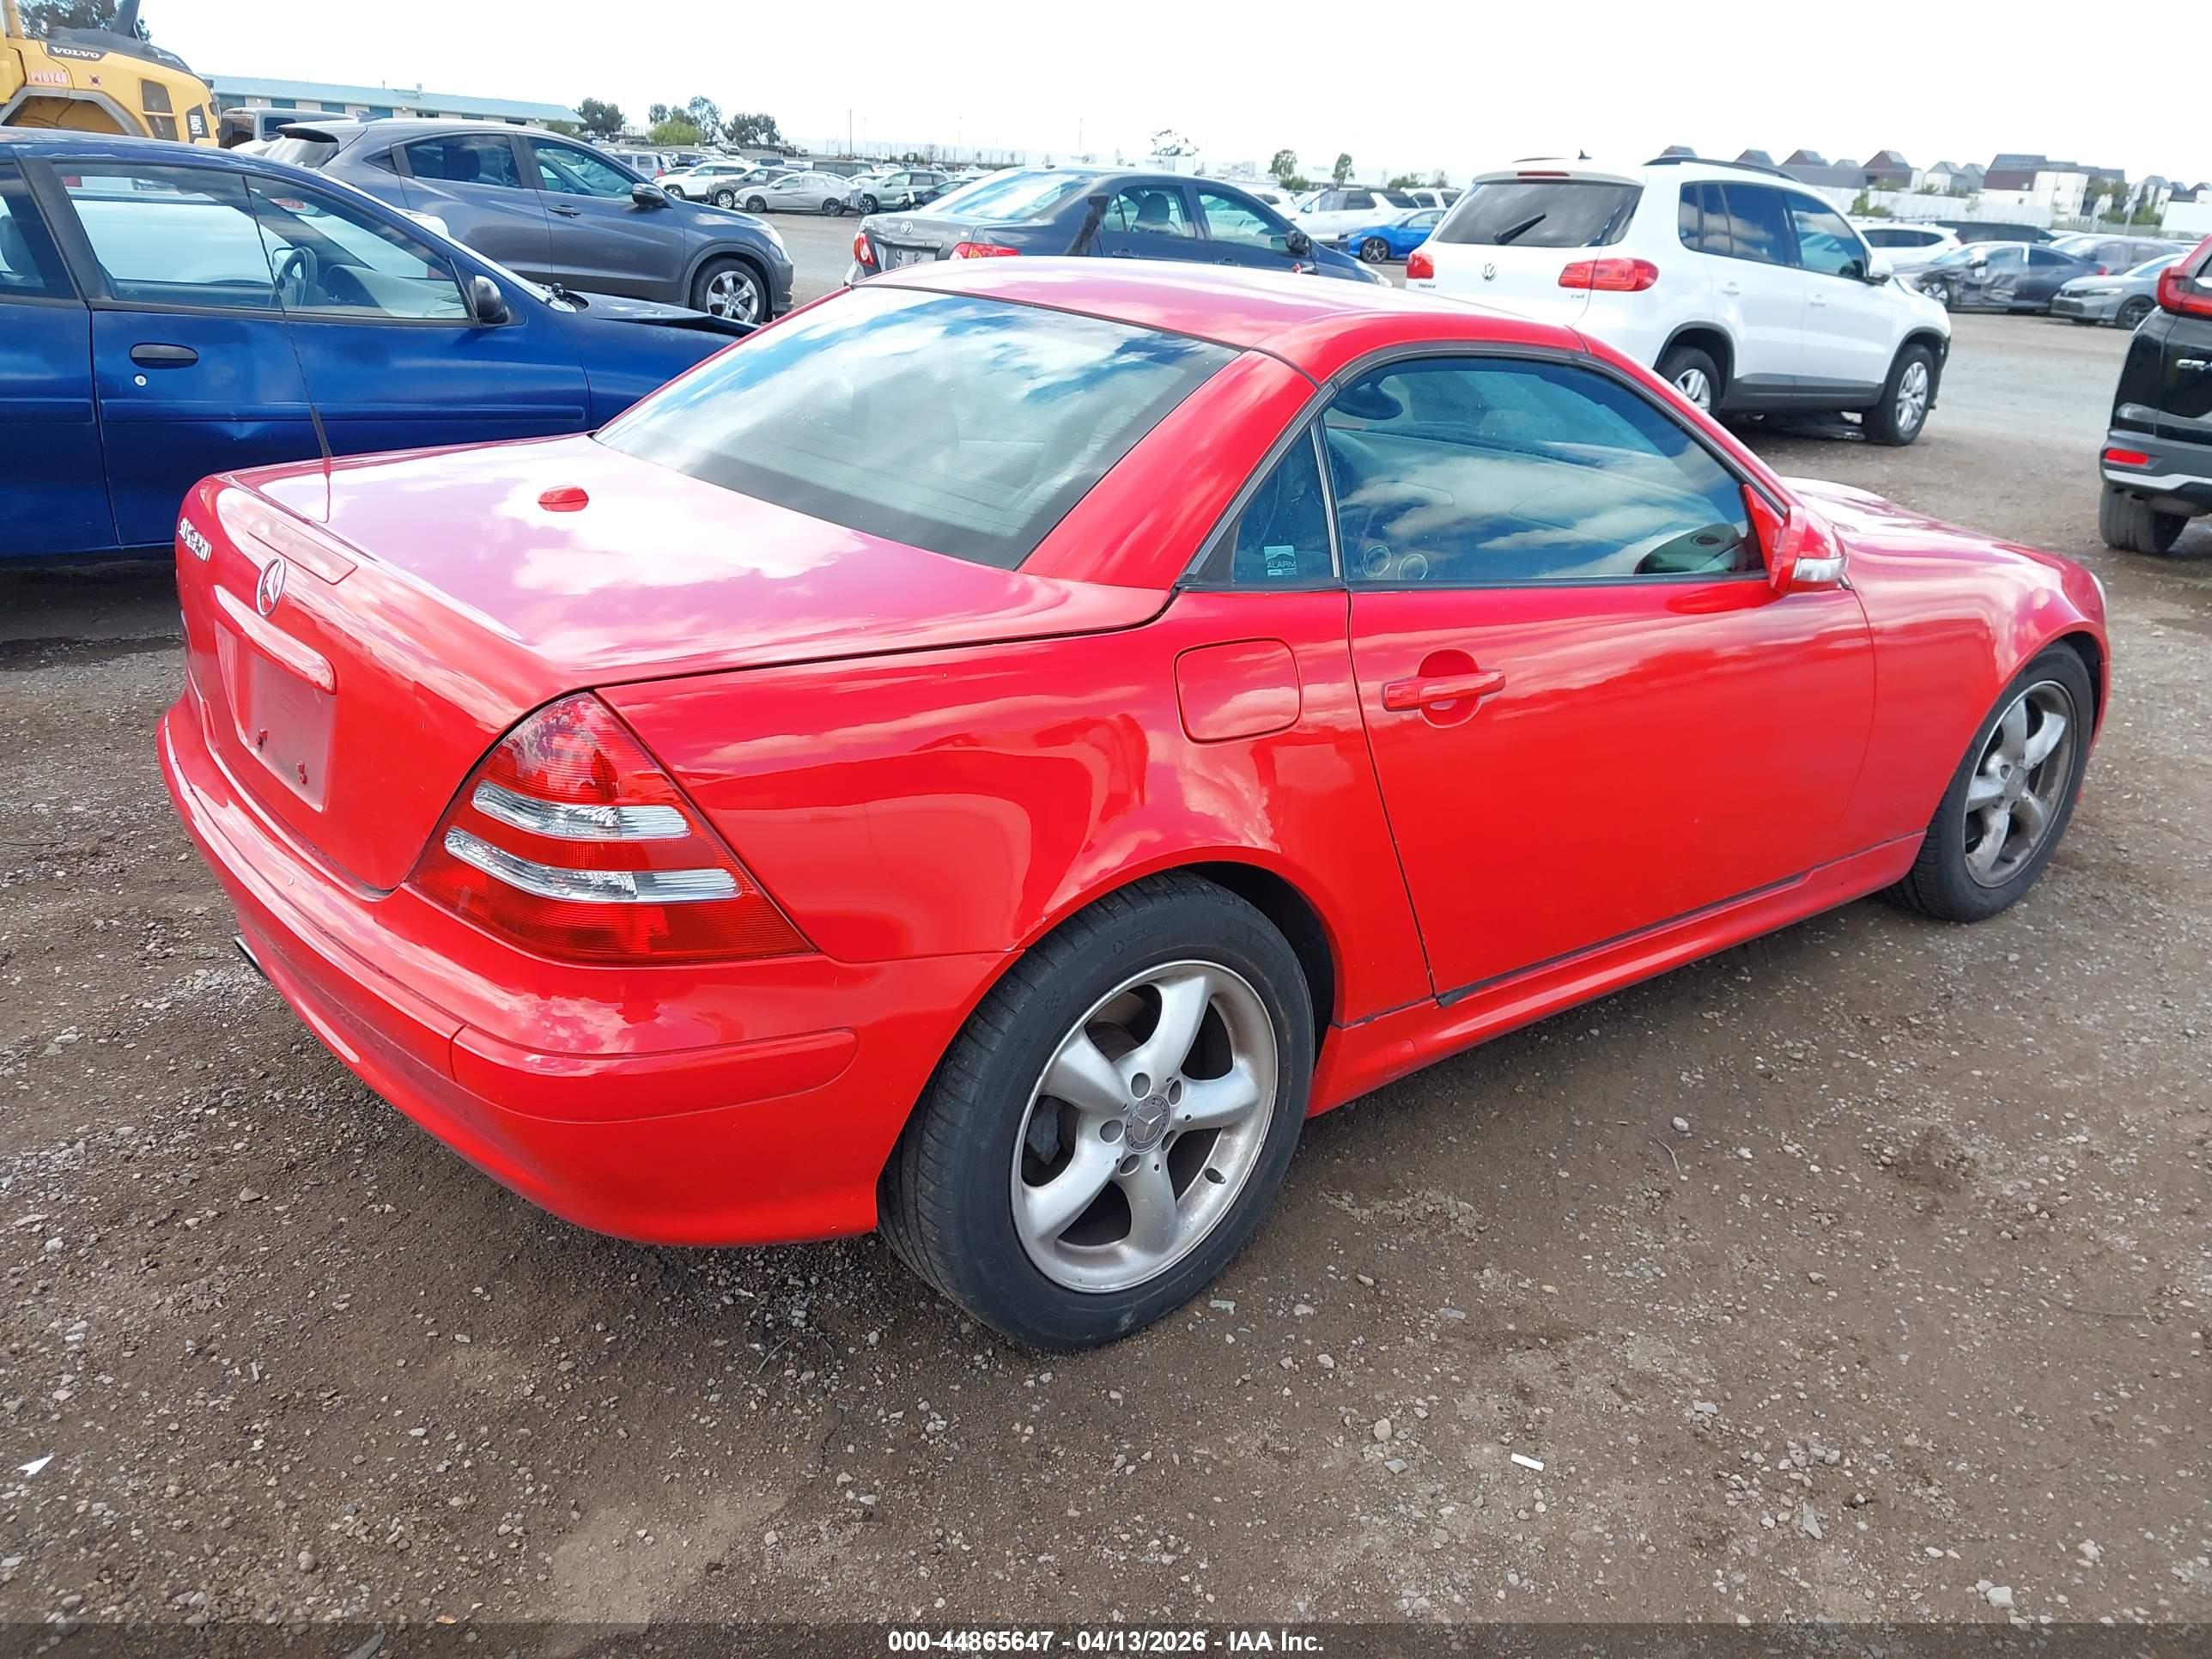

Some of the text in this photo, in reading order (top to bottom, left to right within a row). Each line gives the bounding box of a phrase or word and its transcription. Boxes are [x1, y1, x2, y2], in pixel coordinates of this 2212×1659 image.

[51, 46, 100, 58] VOLVO
[2176, 359, 2212, 371] CR-
[1267, 560, 1297, 568] ALARM
